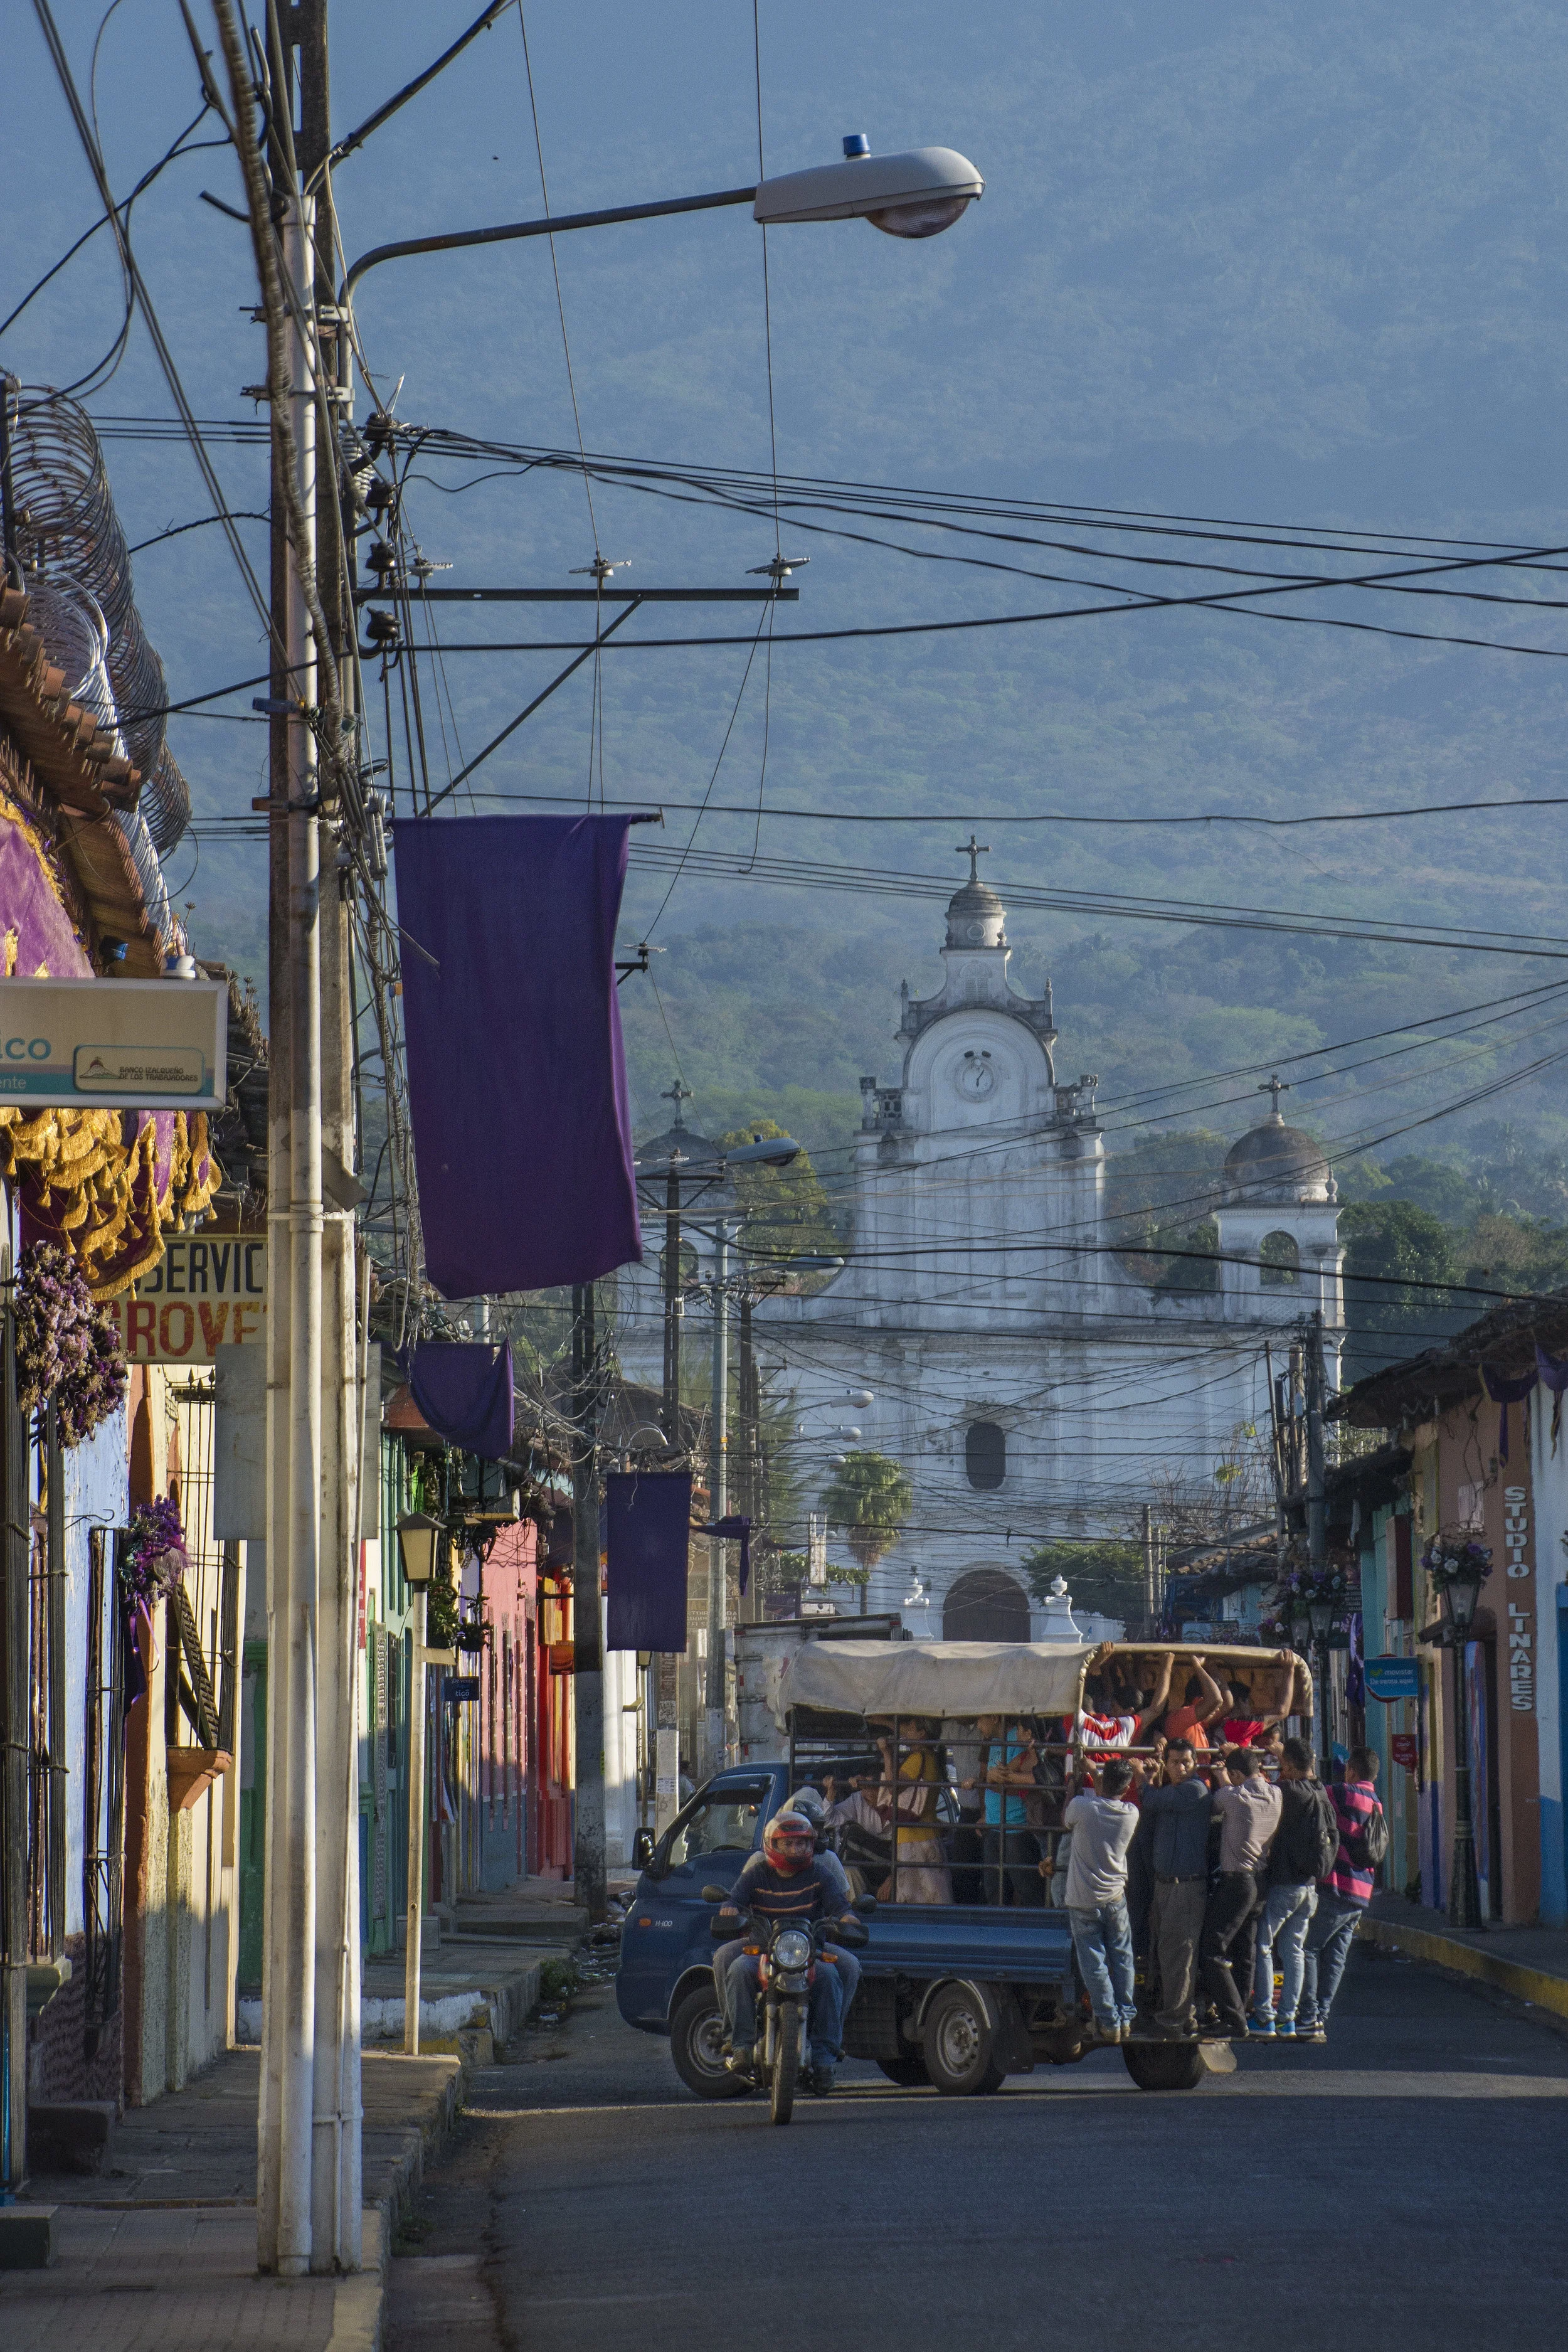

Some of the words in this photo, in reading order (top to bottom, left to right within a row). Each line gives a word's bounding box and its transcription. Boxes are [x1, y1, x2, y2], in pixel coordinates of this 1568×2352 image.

[0, 1037, 51, 1060] CO
[146, 1066, 184, 1074] IZALQUEÑO
[0, 1075, 26, 1089] nte
[1505, 1486, 1530, 1578] STUDIO
[1508, 1602, 1533, 1711] LINARES
